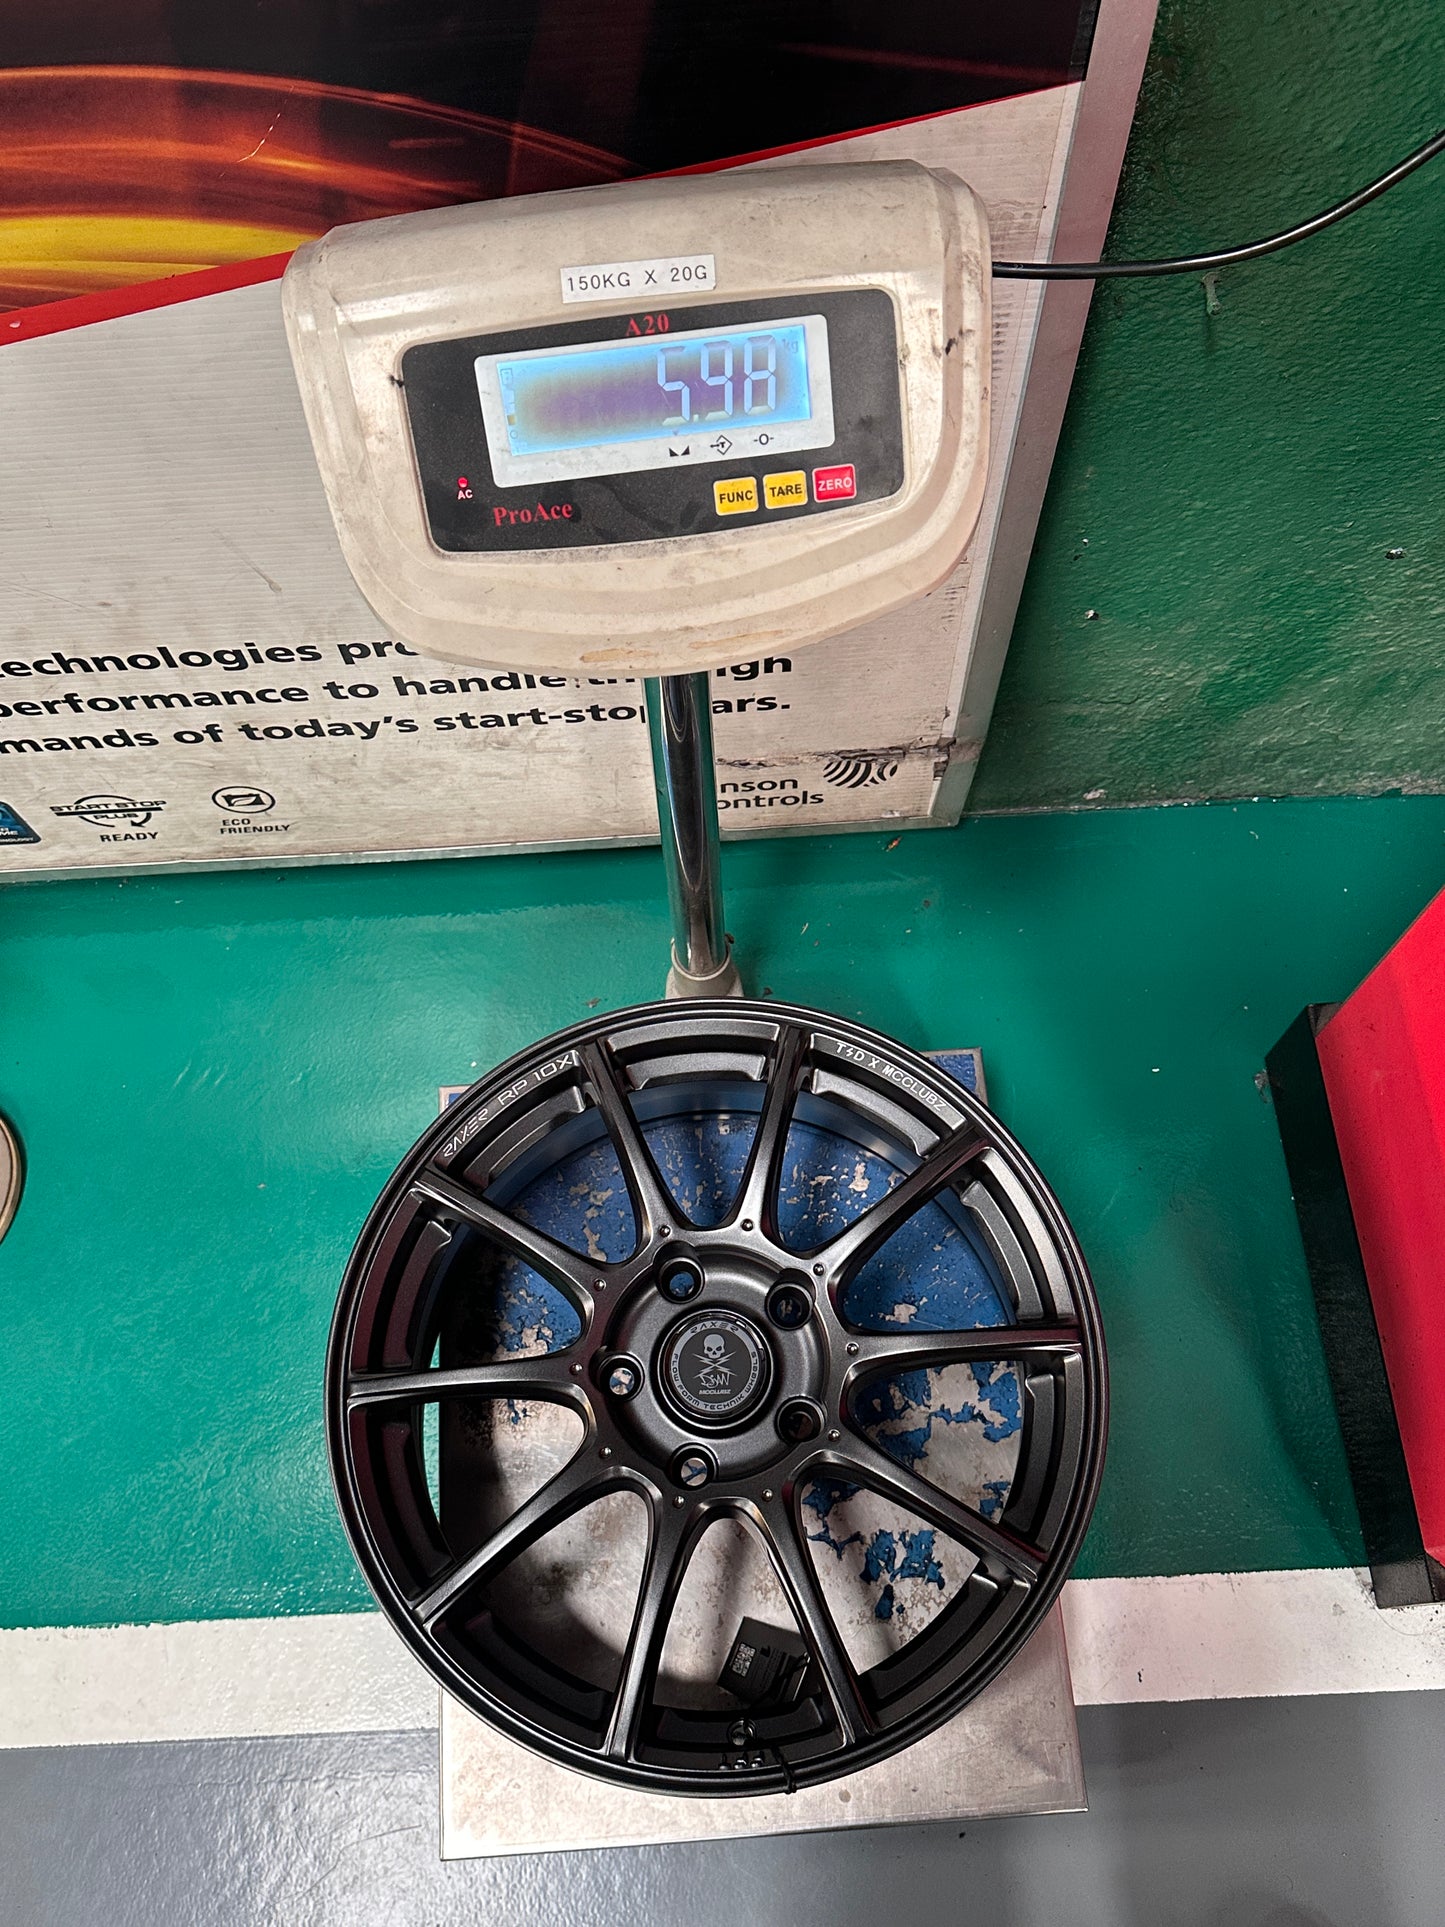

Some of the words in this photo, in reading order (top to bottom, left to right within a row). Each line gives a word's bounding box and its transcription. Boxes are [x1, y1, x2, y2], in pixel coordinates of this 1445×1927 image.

[567, 272, 631, 292] 150KG
[644, 269, 658, 285] X
[670, 264, 708, 283] 20G
[625, 312, 671, 337] A20
[656, 334, 777, 427] 5.98
[457, 489, 474, 500] AC
[719, 489, 754, 505] FUNC
[769, 483, 803, 498] TARE
[817, 476, 853, 492] ZERO
[493, 502, 573, 526] ProAce
[0, 642, 323, 678] echnologies
[322, 680, 379, 700] to
[392, 671, 567, 697] handle
[173, 723, 223, 745] of
[237, 715, 420, 741] today's
[433, 704, 647, 731] start-sto
[49, 803, 112, 812] START
[115, 800, 167, 809] STOP
[220, 824, 291, 835] FRIENDLY
[222, 818, 251, 826] ECO
[100, 832, 159, 843] READY
[497, 1079, 529, 1106] RP
[533, 1053, 573, 1082] 10X
[868, 1057, 882, 1069] X
[881, 1063, 948, 1112] MCCLUBZ
[677, 1383, 701, 1407] FORM
